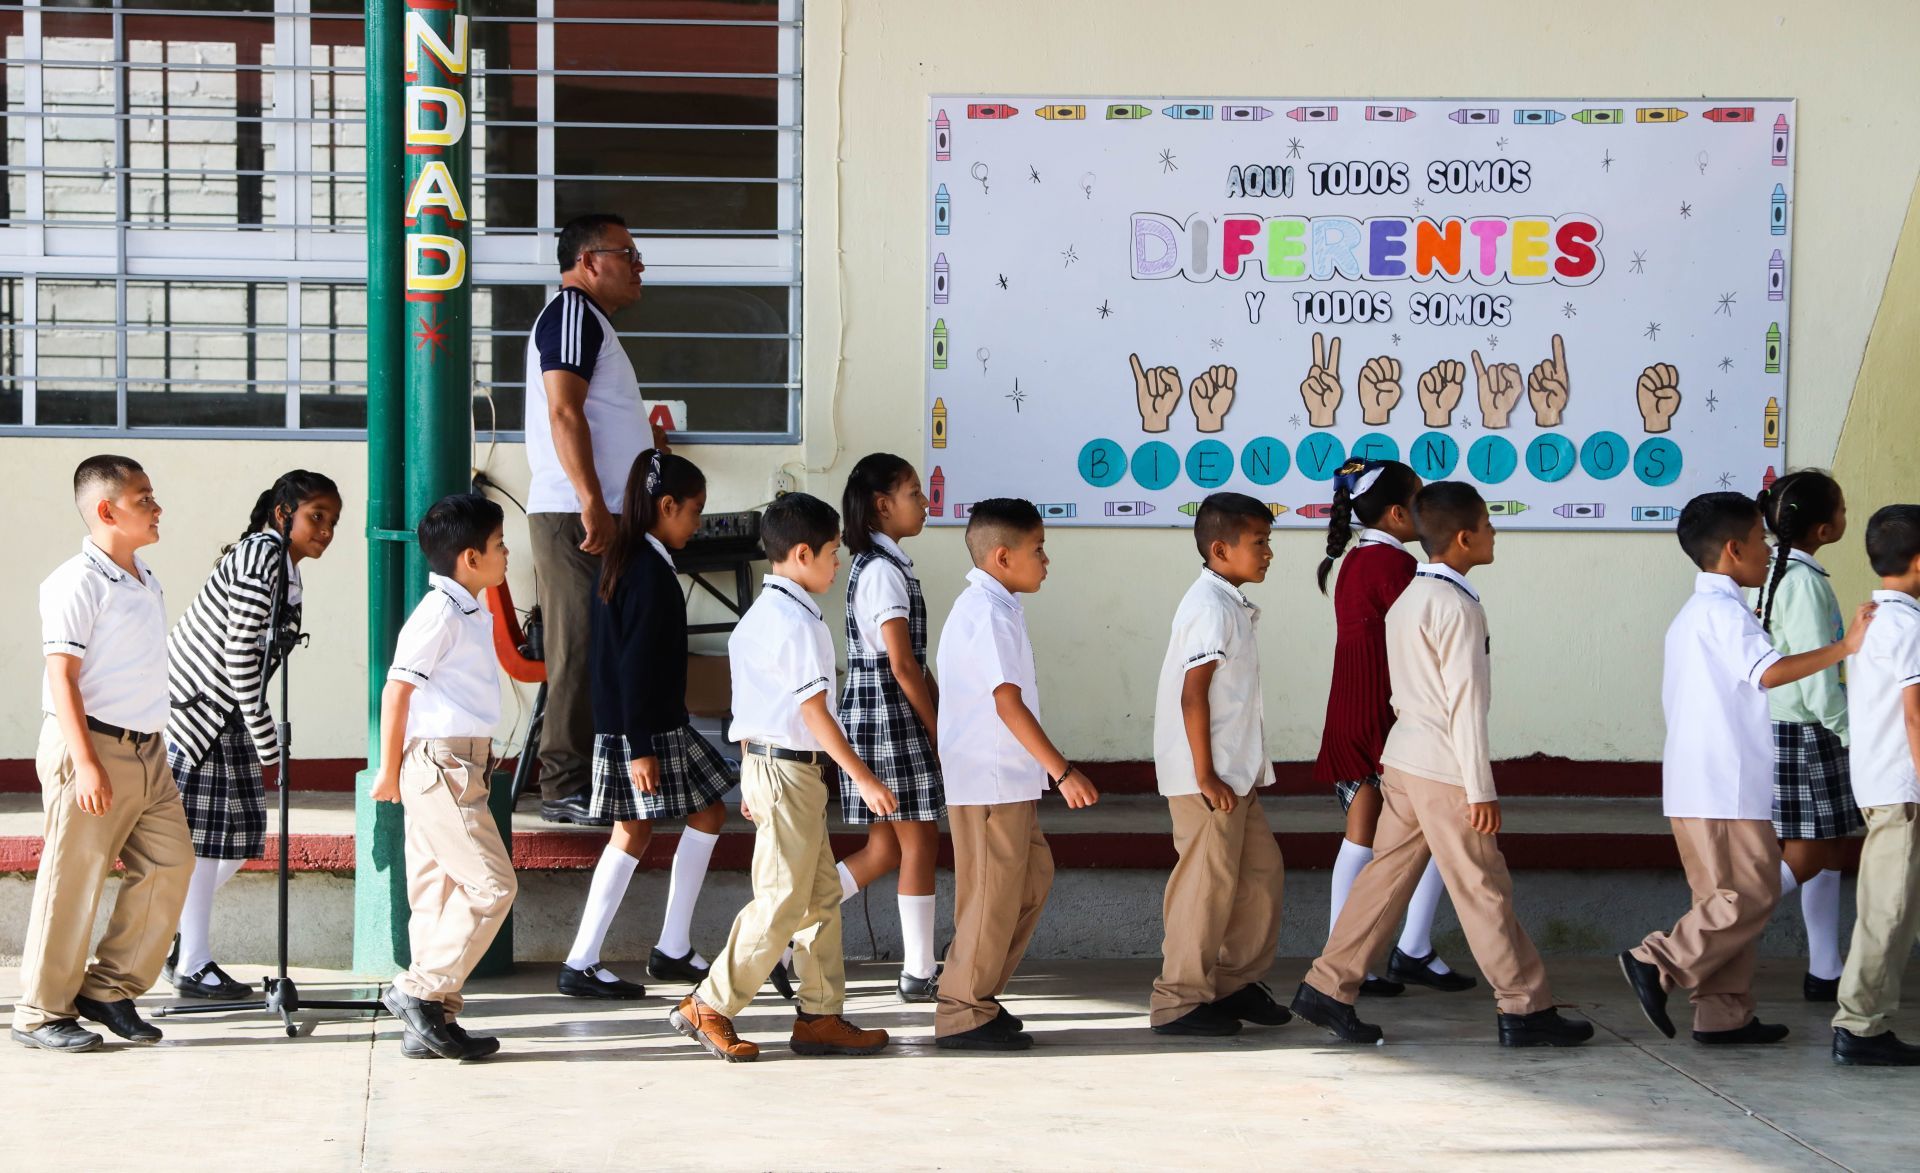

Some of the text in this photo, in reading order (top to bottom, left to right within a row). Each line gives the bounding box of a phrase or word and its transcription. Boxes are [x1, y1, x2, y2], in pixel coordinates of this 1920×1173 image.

[404, 0, 468, 302] NDAD
[1227, 160, 1531, 198] AQUI TODOS SOMOS
[1131, 213, 1605, 286] DIFERENTES
[1245, 290, 1512, 327] Y TODOS SOMOS
